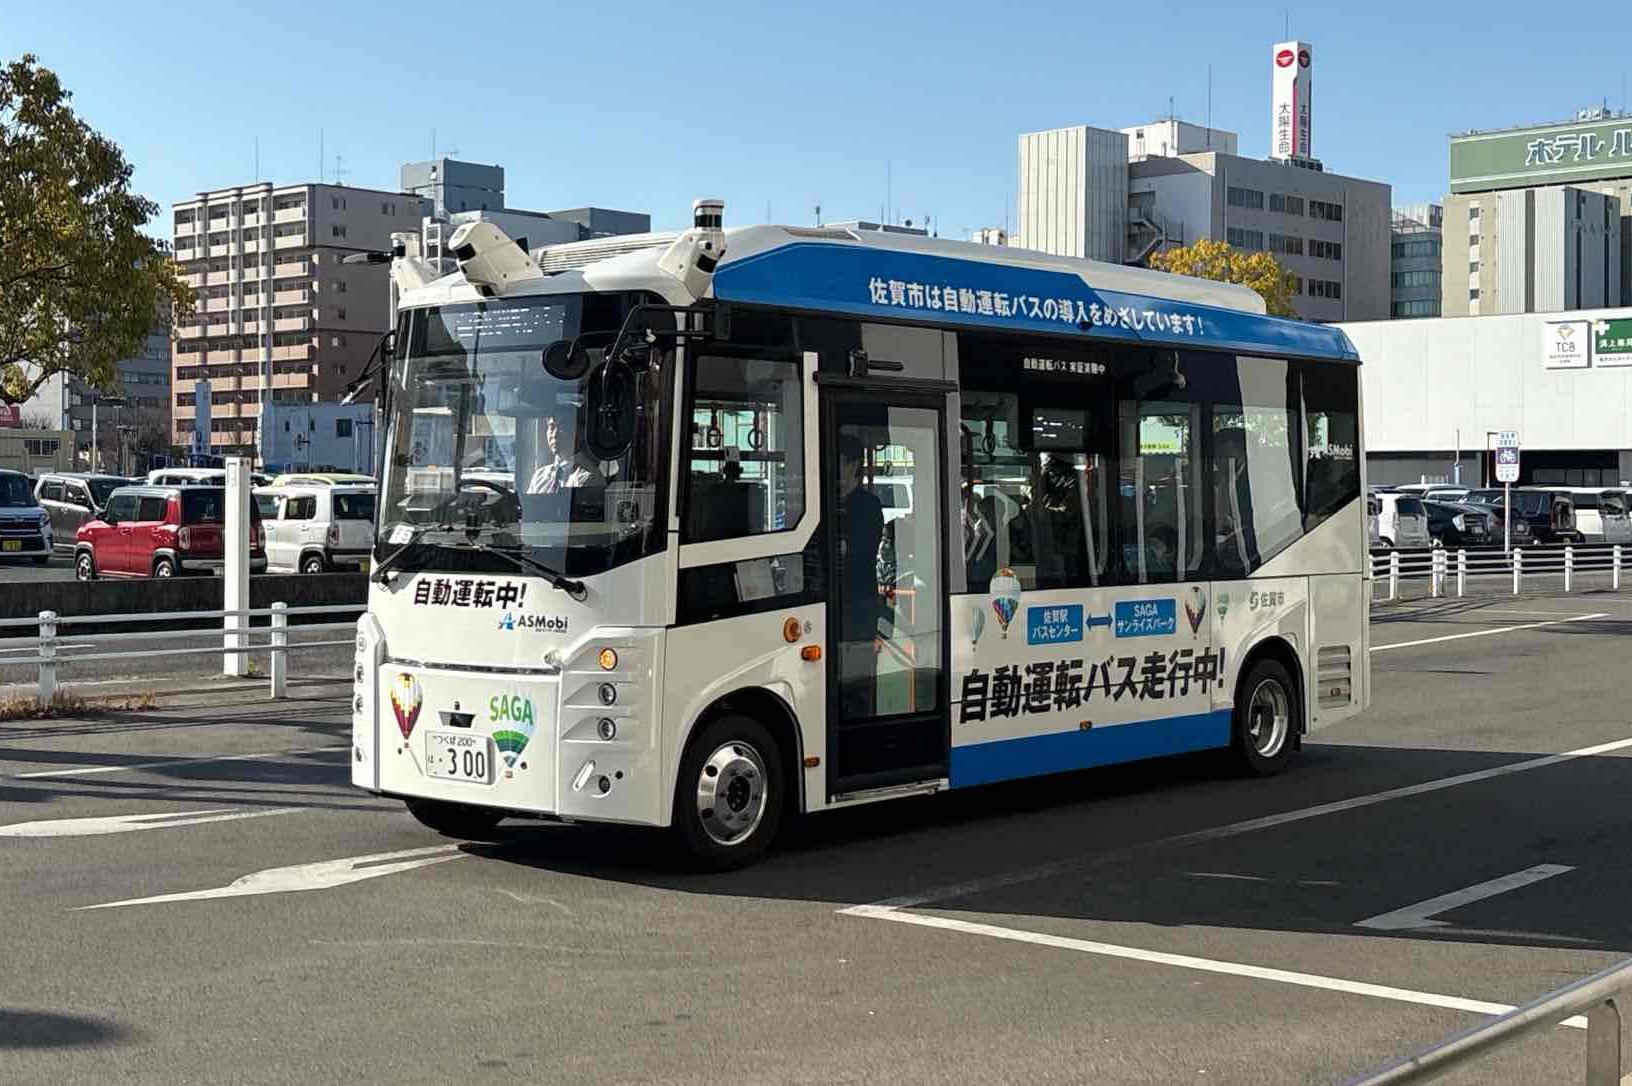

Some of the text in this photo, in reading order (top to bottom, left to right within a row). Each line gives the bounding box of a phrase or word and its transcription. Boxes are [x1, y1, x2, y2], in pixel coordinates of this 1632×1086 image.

[1525, 133, 1605, 166] ホテル
[868, 276, 1204, 336] 佐賀市は自動運転バスの導入をめざしています!
[413, 578, 527, 609] 自動運転中!
[517, 615, 568, 629] ASMobi
[1043, 607, 1069, 624] 佐賀駅
[1133, 603, 1159, 617] SAGA
[1032, 625, 1080, 639] バスセンター
[1117, 617, 1175, 633] サンライズパーク
[959, 647, 1226, 724] 自動運転バス走行中!
[489, 694, 534, 725] SAGA
